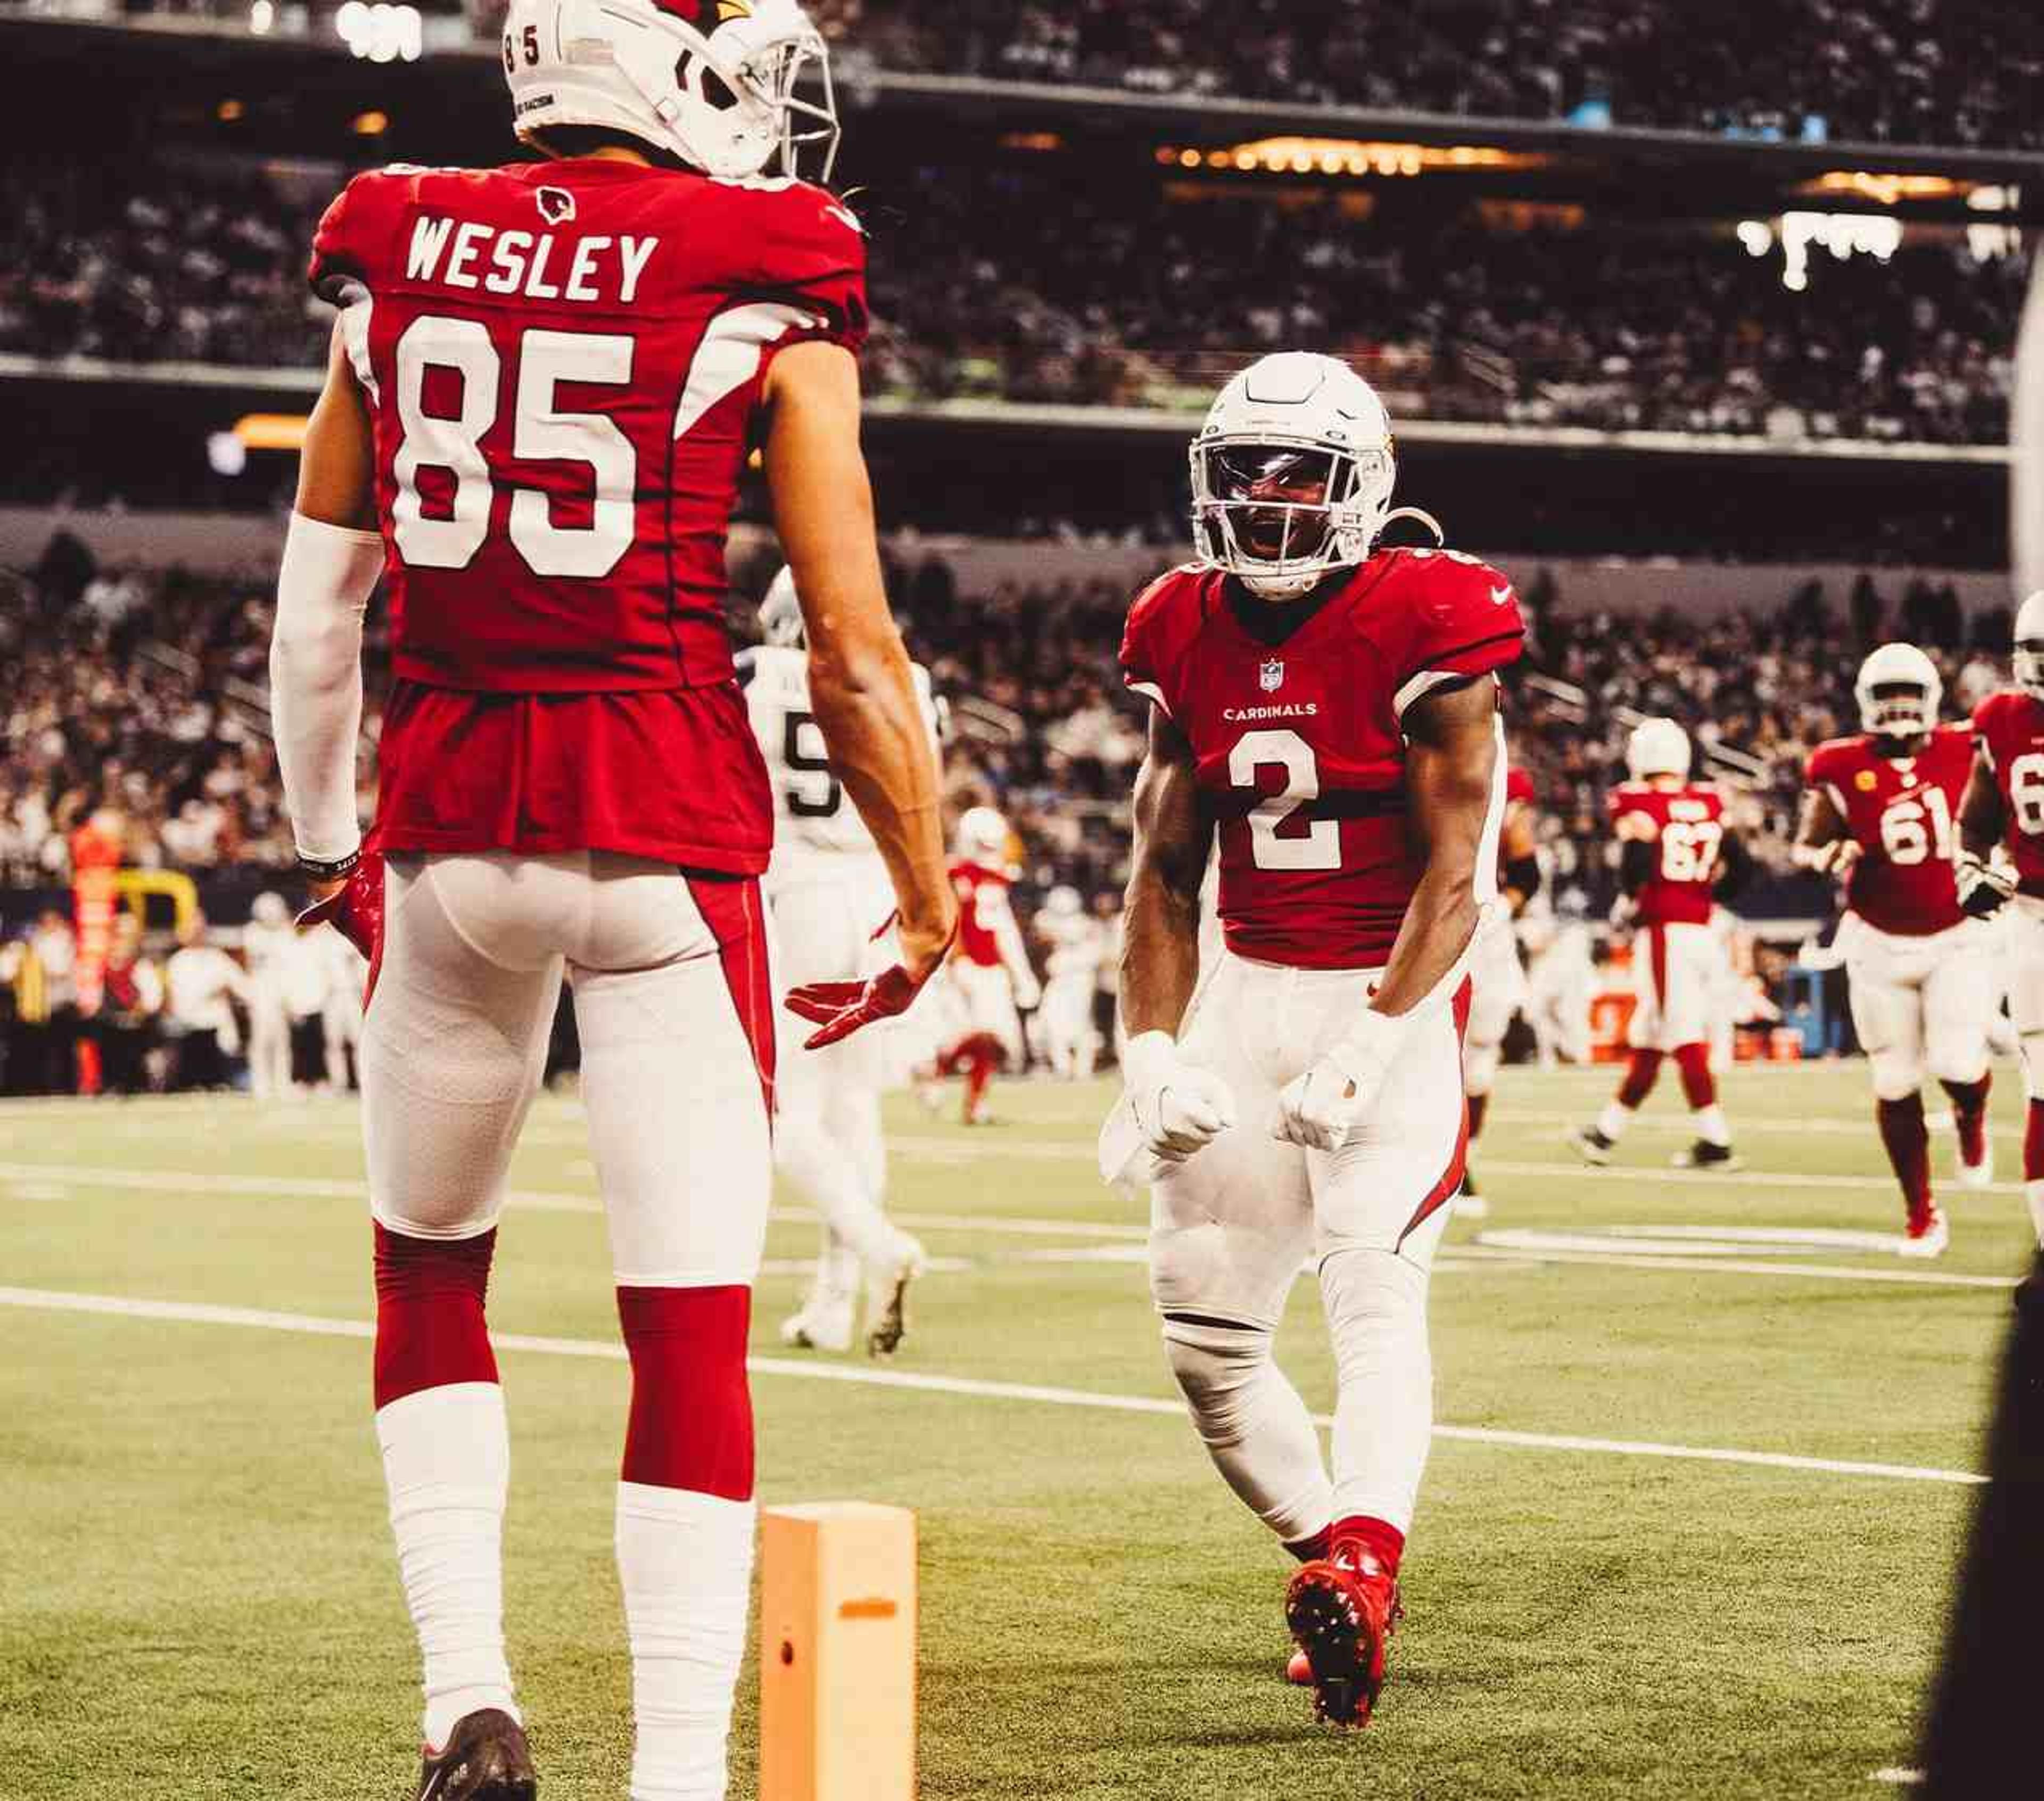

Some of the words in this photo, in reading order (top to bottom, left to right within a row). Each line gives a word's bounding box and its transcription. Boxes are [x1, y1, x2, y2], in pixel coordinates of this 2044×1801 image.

[406, 216, 658, 303] WESLEY
[392, 316, 637, 579] 85
[1223, 703, 1317, 721] CARDINALS
[1229, 729, 1341, 870] 2
[1880, 786, 1953, 865] 61
